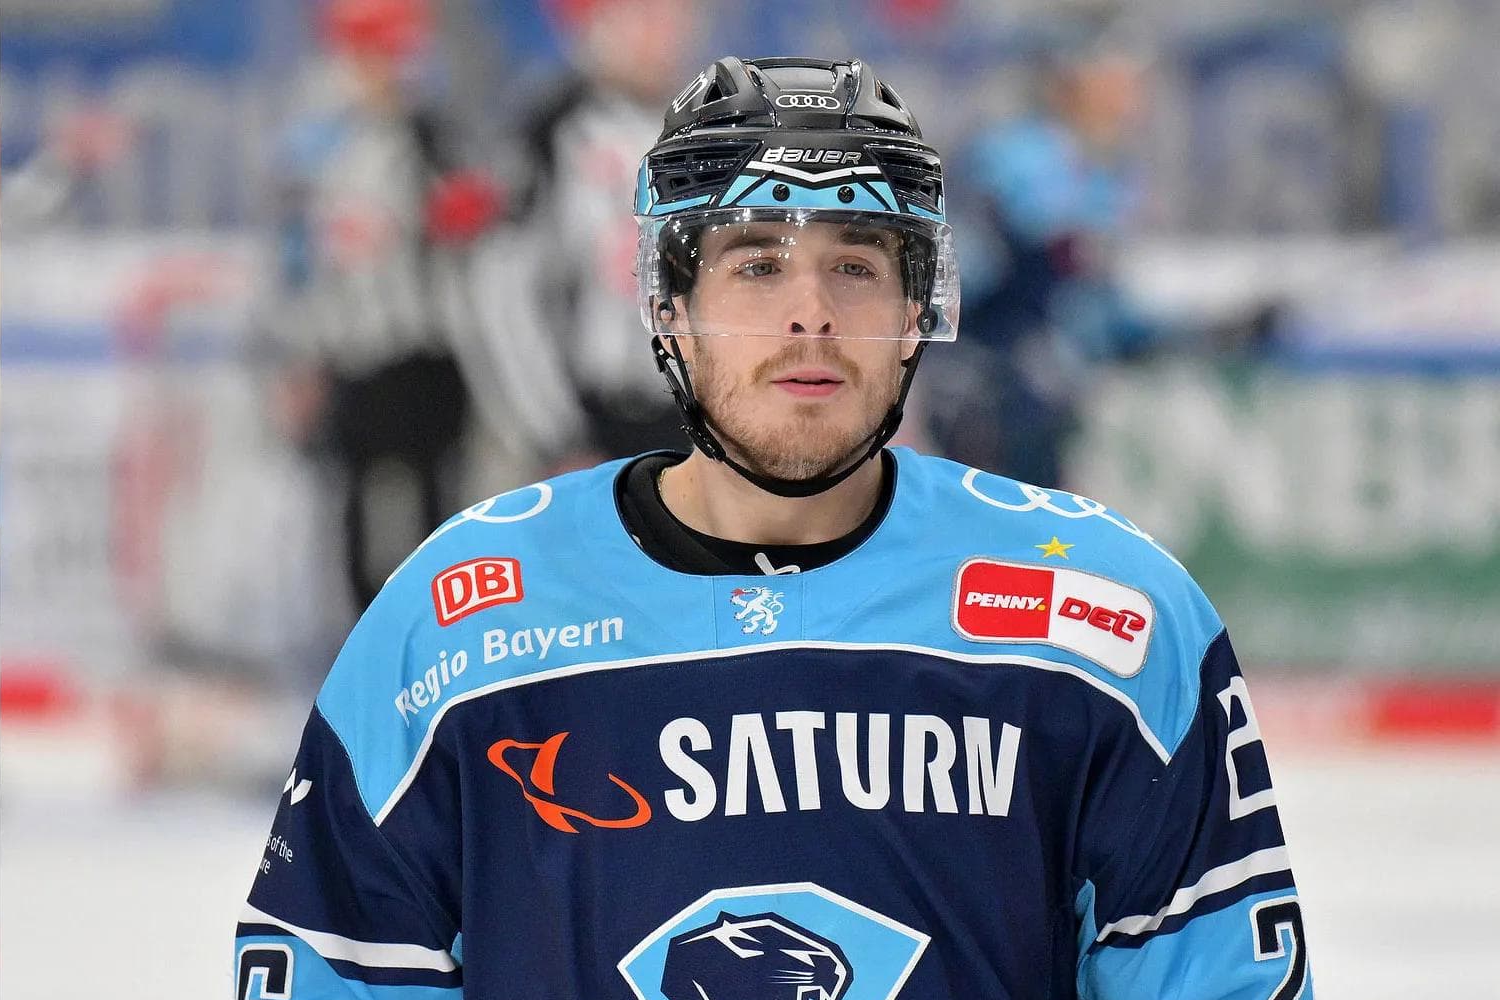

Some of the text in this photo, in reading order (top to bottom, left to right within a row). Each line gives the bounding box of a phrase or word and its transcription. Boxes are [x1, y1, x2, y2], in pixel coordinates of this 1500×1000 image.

[441, 562, 509, 615] DB
[482, 615, 625, 666] Bayern
[658, 709, 1022, 822] SATURN
